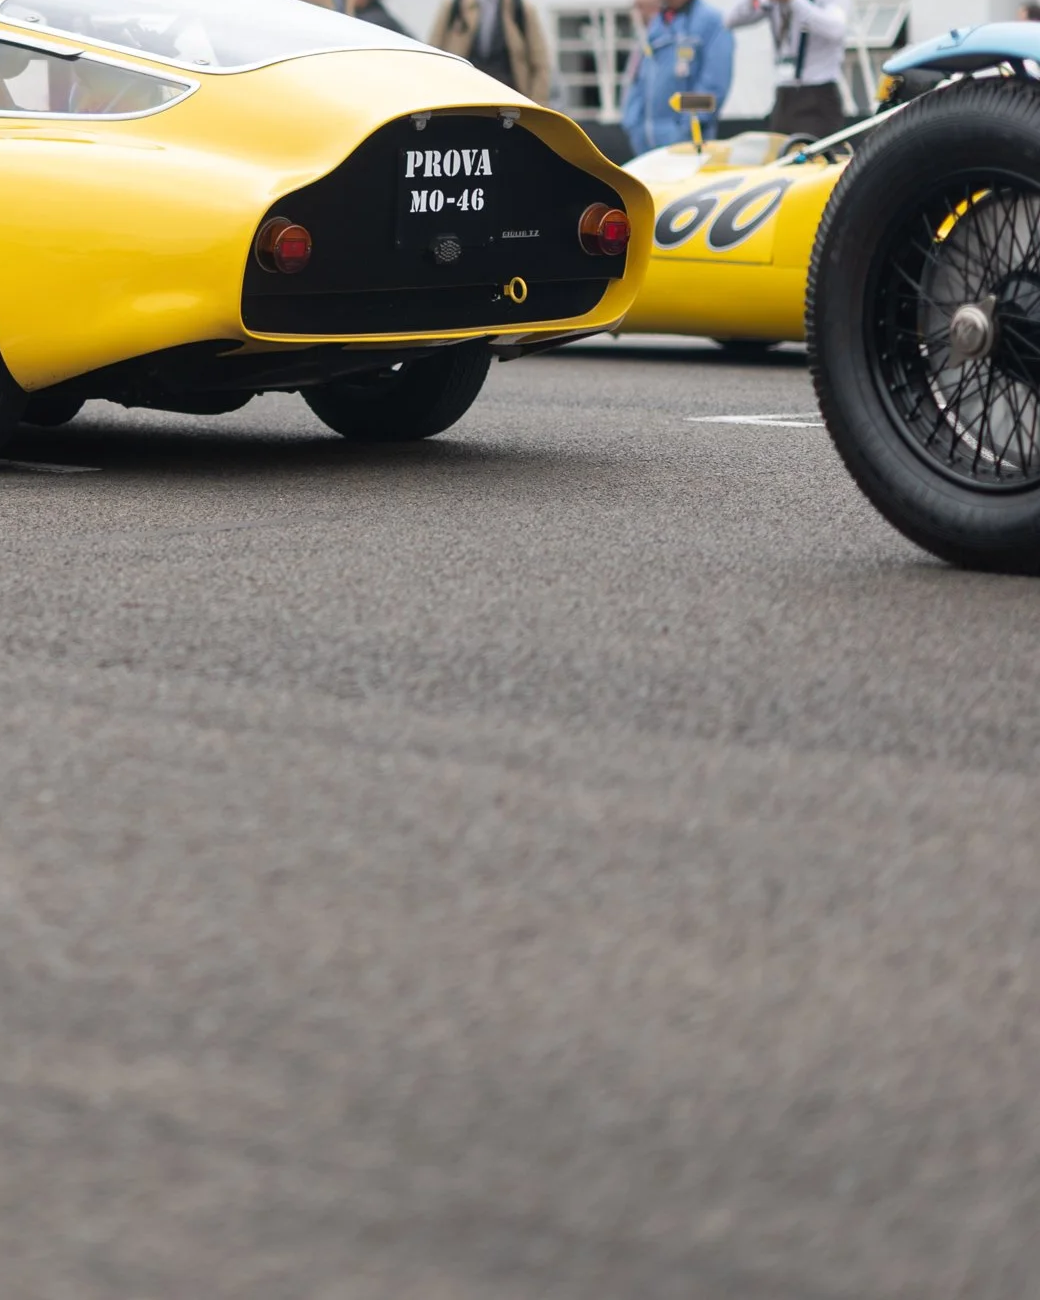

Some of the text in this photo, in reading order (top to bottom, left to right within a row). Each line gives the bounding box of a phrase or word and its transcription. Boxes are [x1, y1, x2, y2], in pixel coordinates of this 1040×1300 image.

[405, 149, 493, 178] PROVA
[409, 188, 485, 213] MO-46
[653, 175, 794, 252] 60
